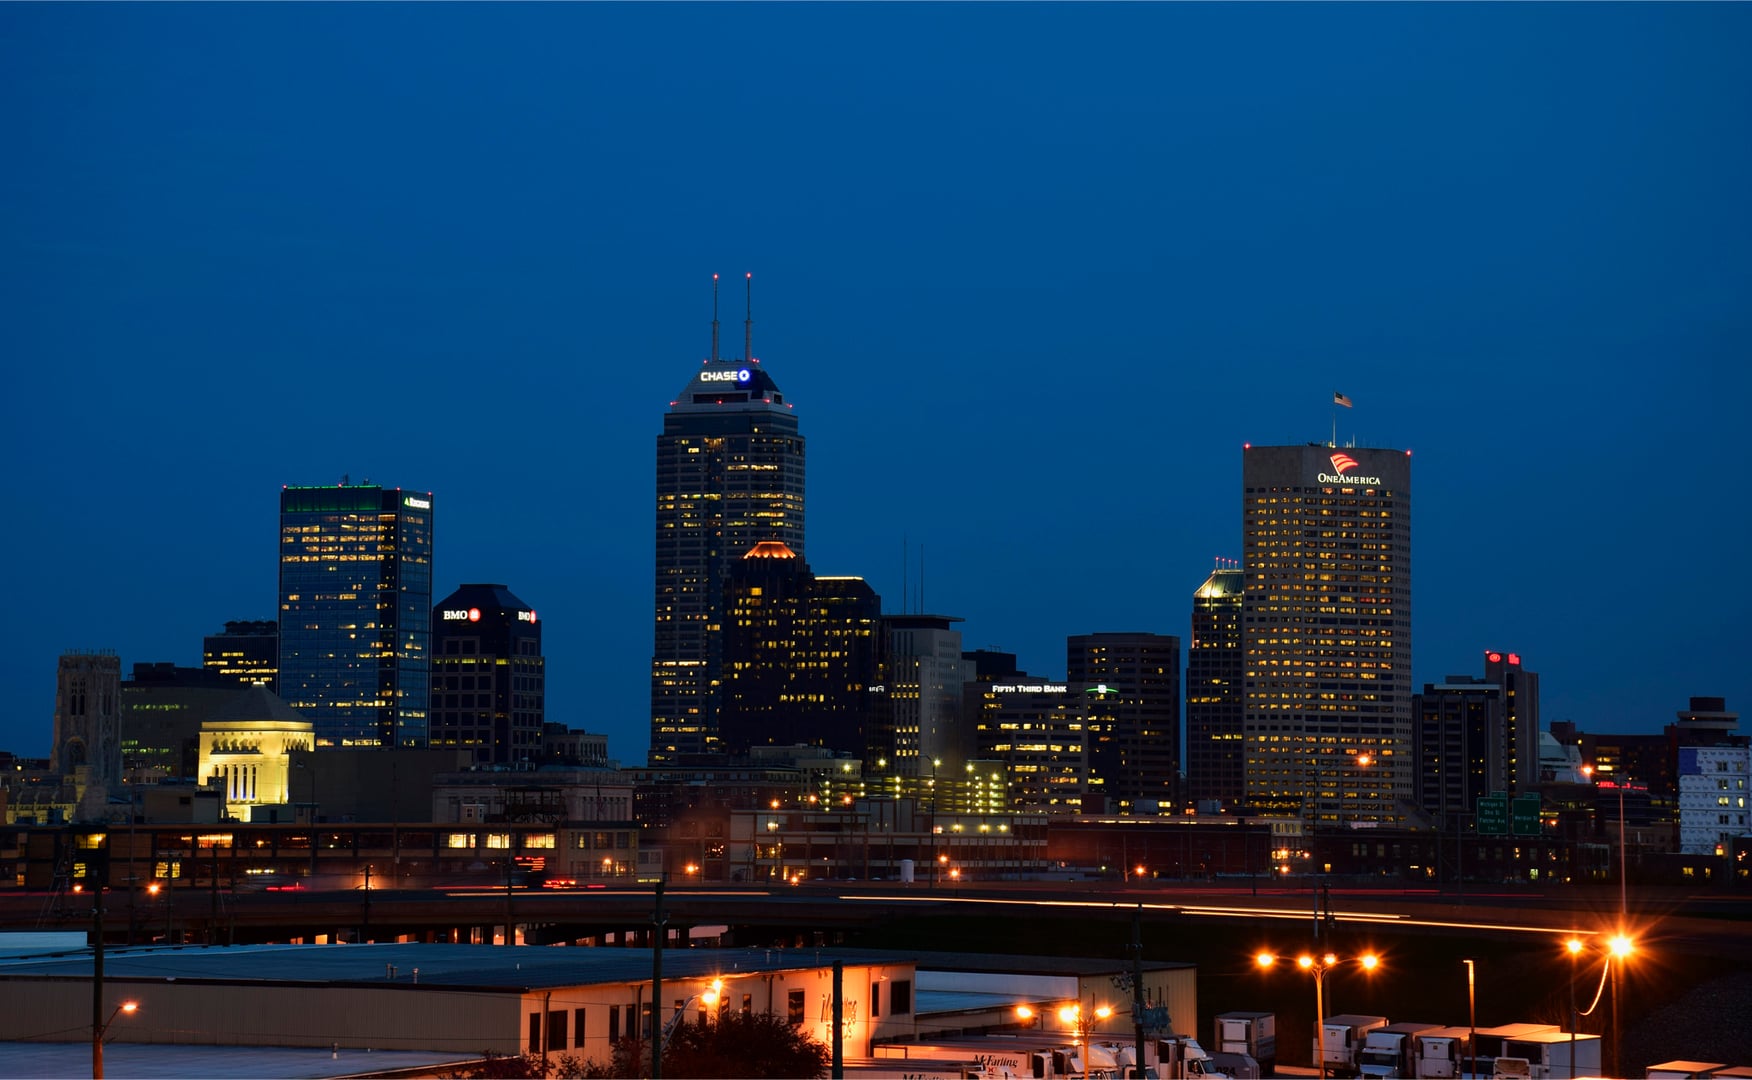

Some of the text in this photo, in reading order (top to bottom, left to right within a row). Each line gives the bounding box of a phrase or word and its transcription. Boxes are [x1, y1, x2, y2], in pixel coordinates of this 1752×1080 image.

[700, 371, 738, 382] CHASE
[443, 610, 468, 620] BMO
[992, 685, 1068, 693] FIFTH THIRD BANK
